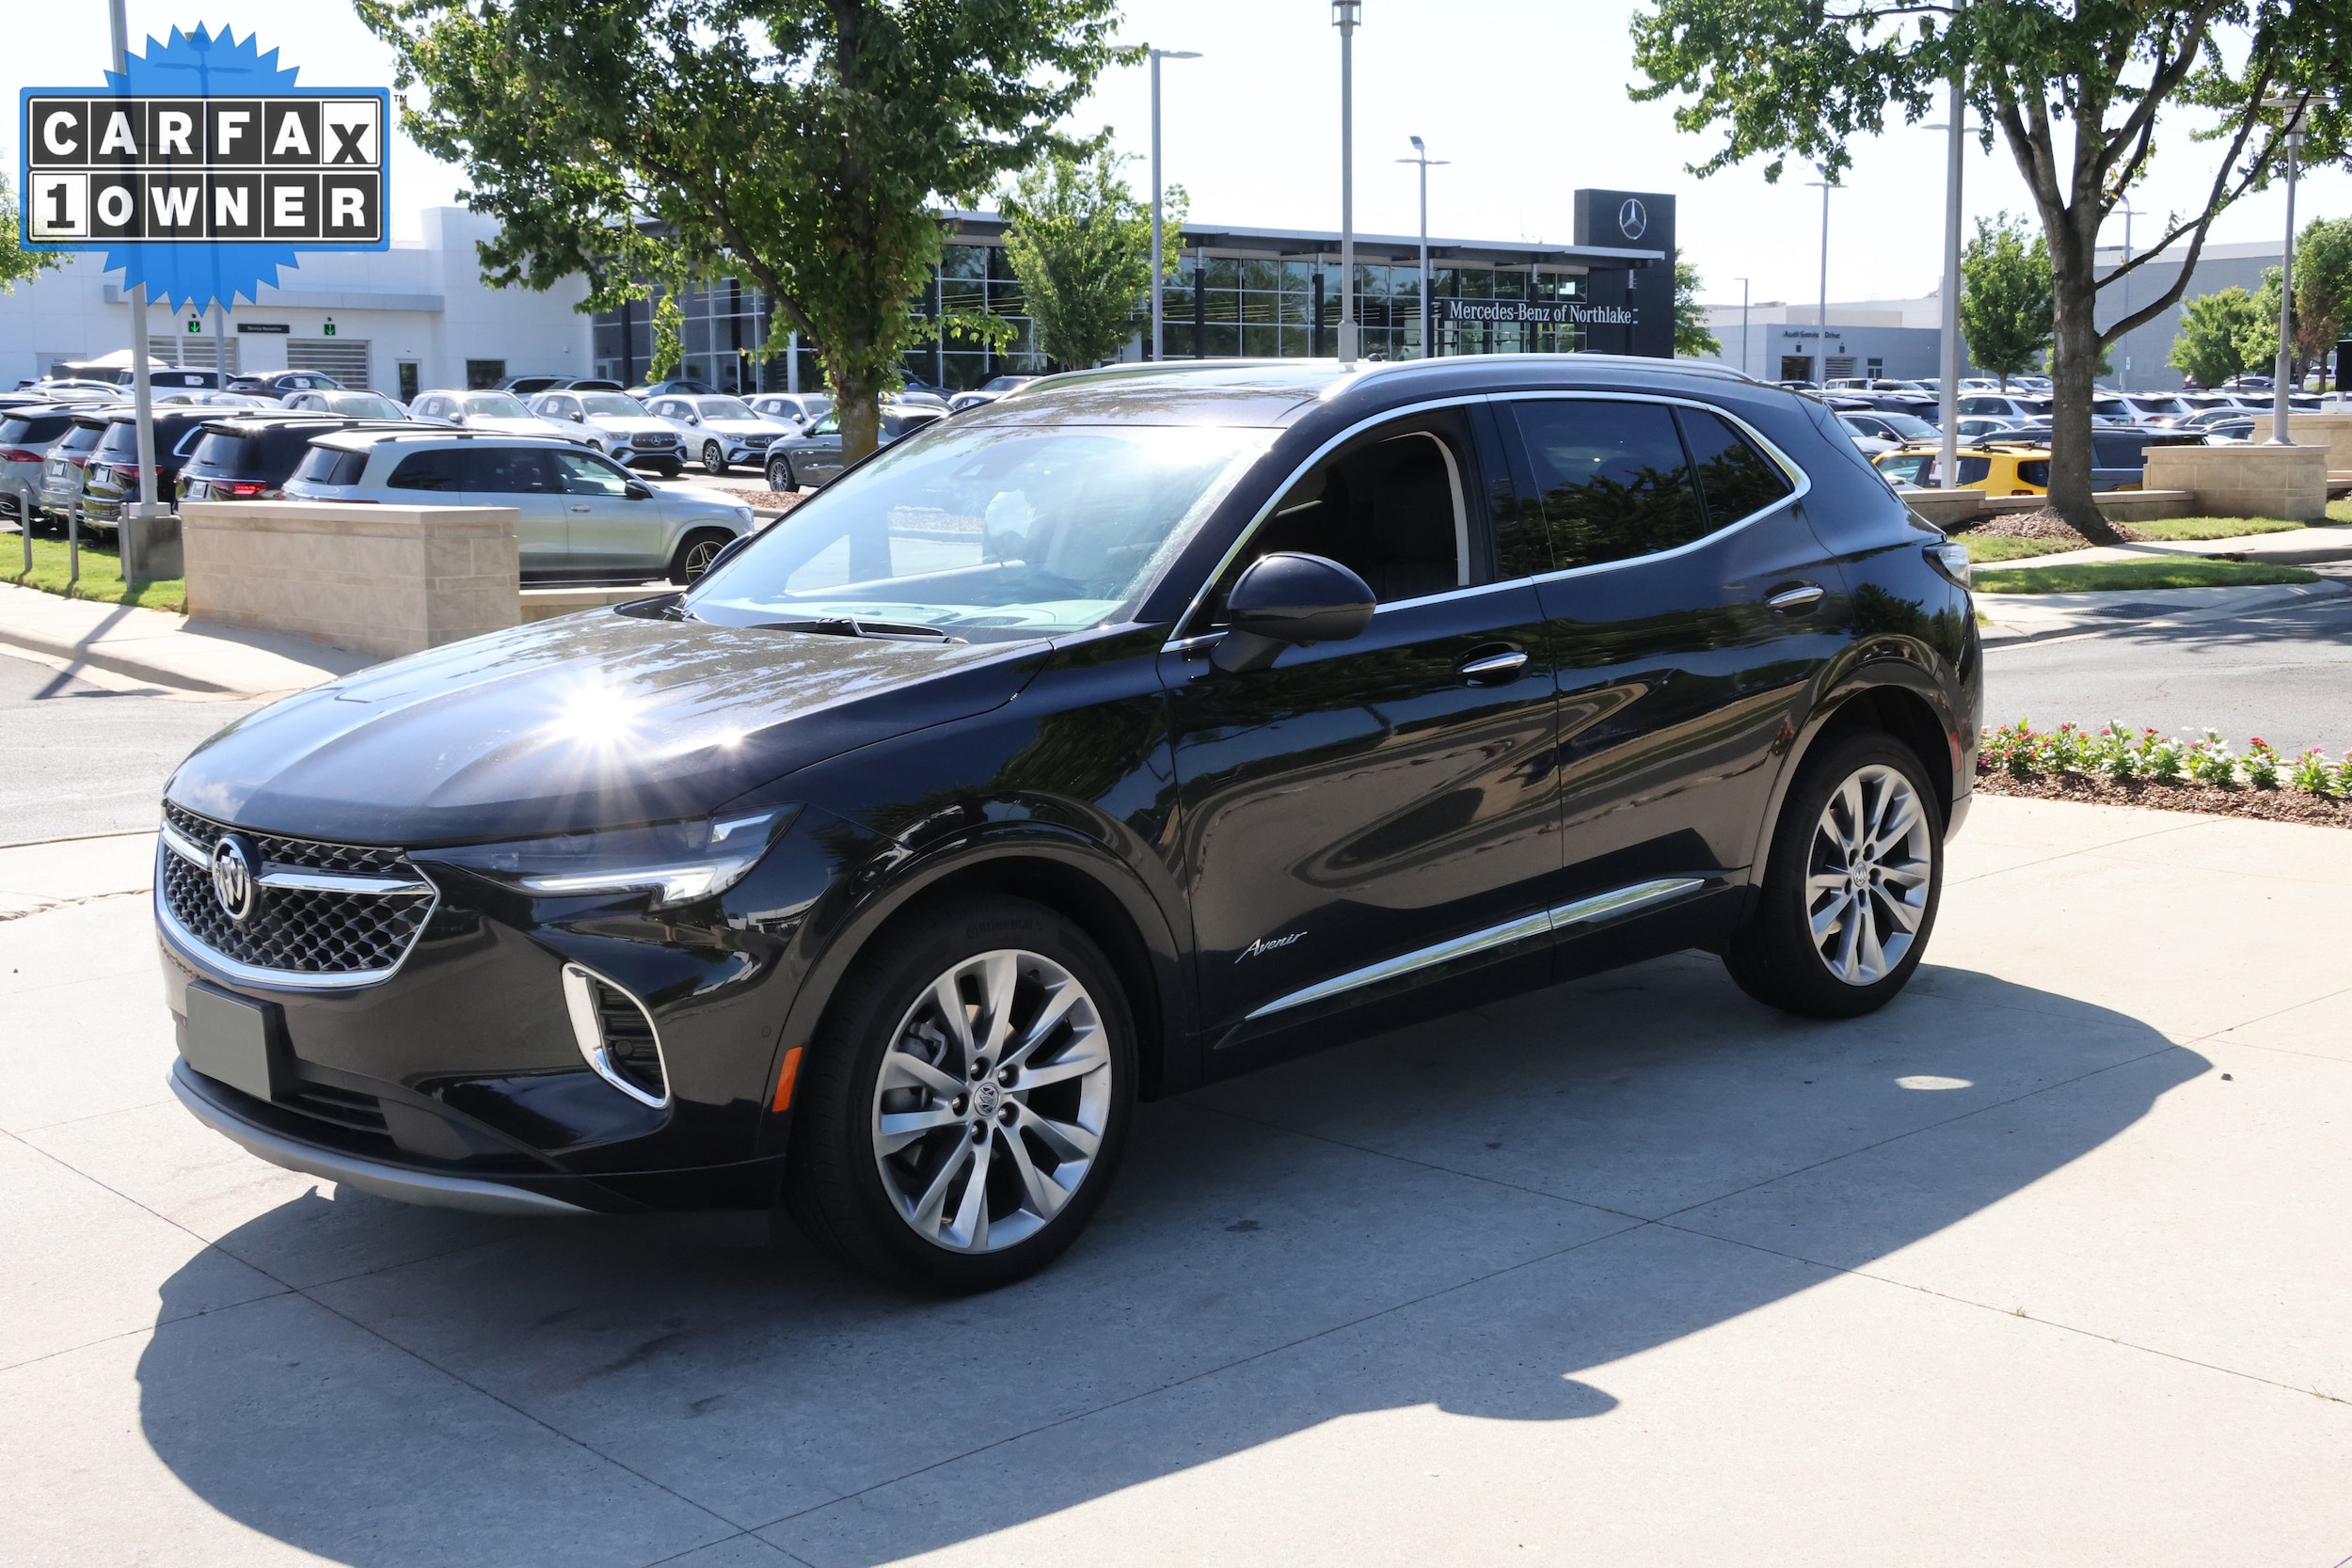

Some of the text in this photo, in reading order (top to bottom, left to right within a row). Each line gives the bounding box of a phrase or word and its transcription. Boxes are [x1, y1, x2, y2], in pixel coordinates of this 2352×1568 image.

[1450, 301, 1632, 325] Mercedes-Benz of Northlake
[1234, 931, 1309, 964] Avenir
